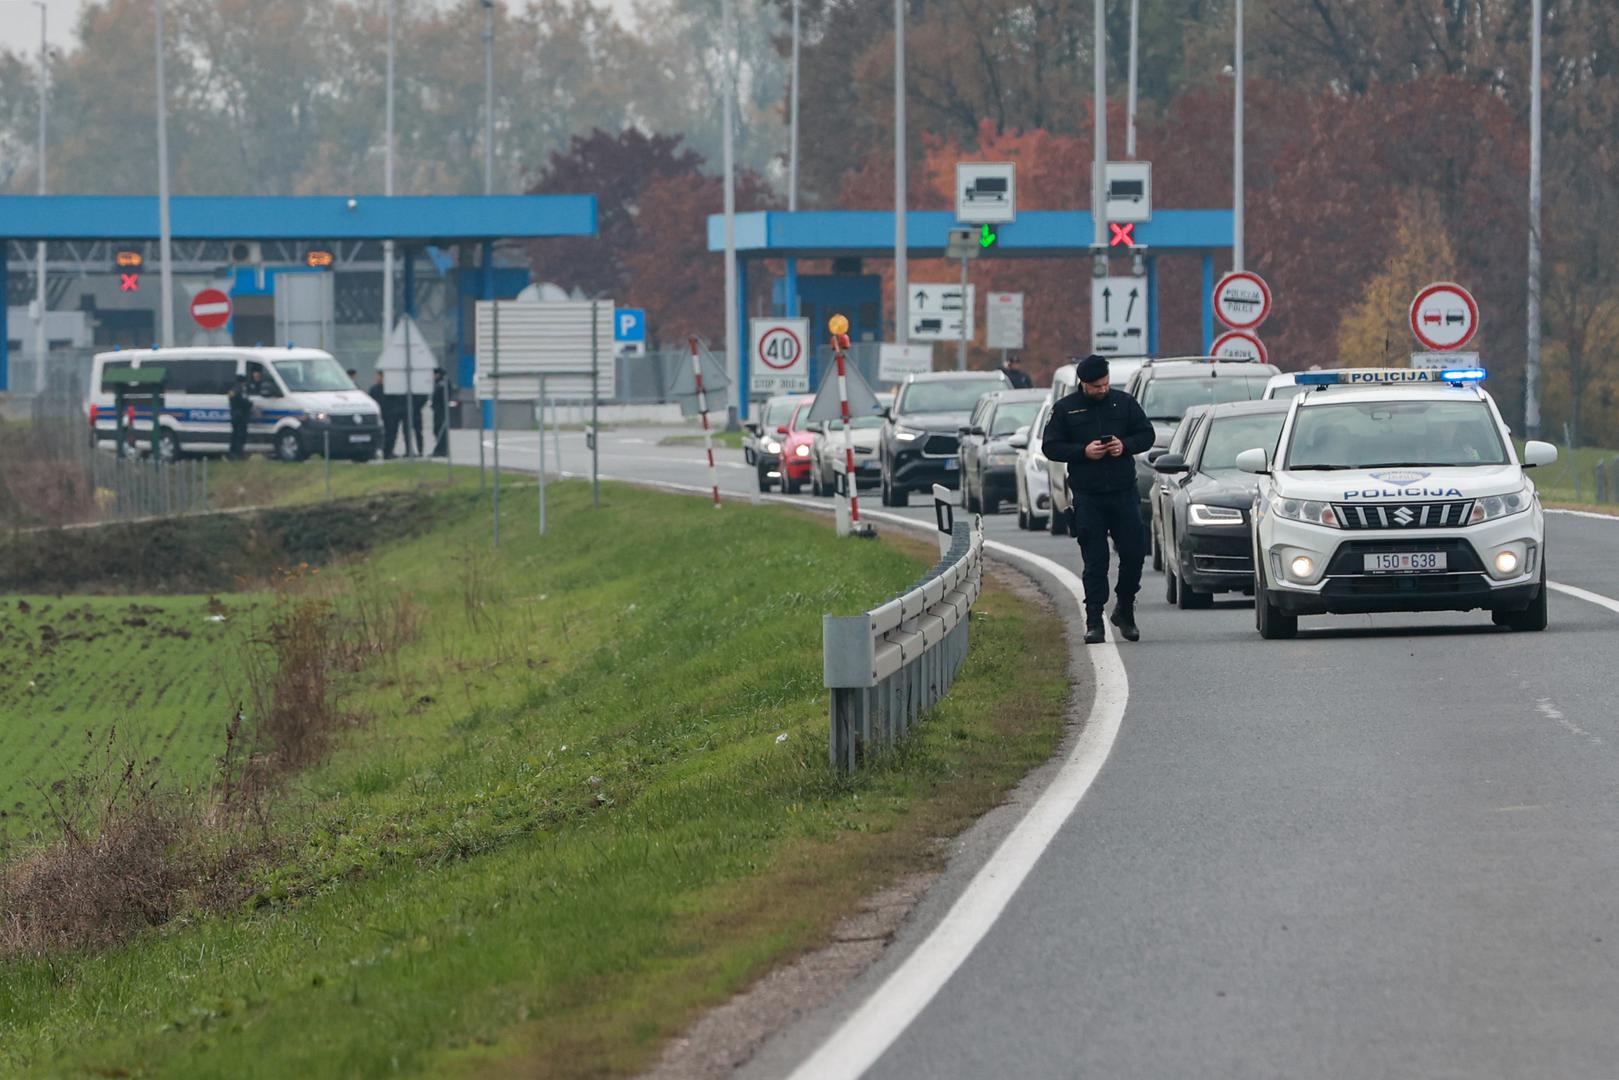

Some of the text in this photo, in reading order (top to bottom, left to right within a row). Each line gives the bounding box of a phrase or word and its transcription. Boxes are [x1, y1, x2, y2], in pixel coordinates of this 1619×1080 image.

[620, 314, 637, 337] P
[766, 337, 794, 360] 40
[1351, 369, 1429, 383] POLICIJA
[1344, 487, 1464, 501] POLICIJA
[1376, 553, 1437, 569] 150 638
